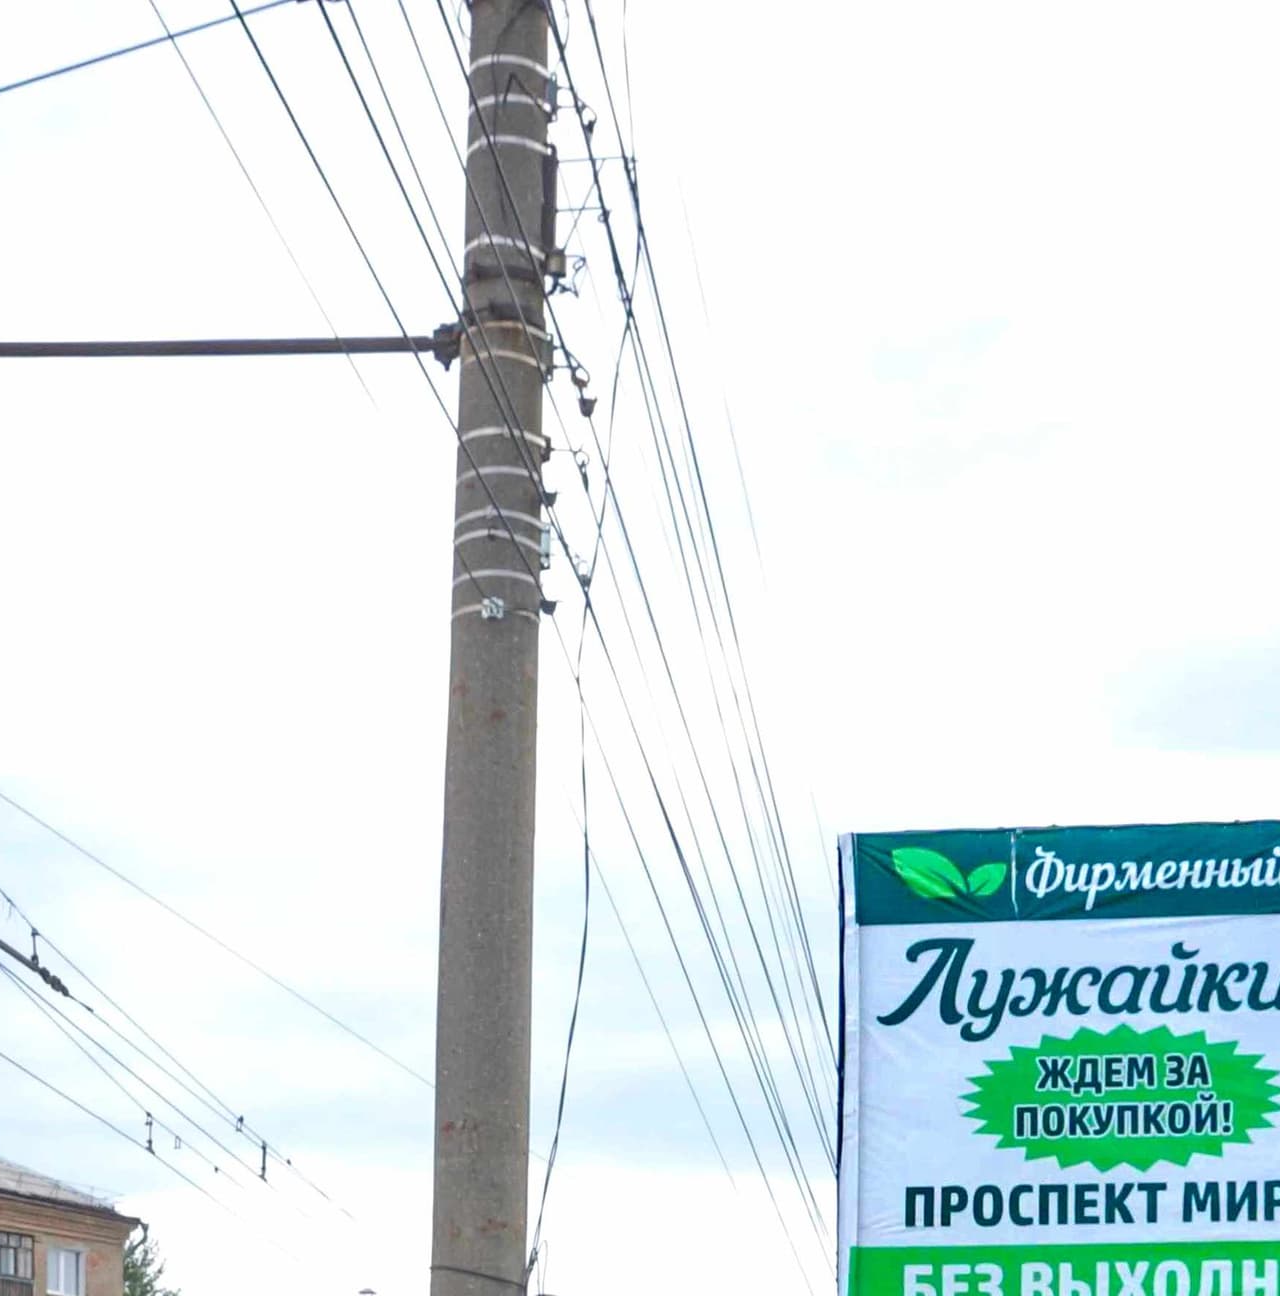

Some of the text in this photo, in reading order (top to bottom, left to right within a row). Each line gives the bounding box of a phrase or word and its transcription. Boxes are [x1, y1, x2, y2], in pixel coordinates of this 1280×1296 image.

[1036, 1054, 1210, 1094] ЖДЕМ ЗА
[1015, 1094, 1234, 1138] ПОКУПКОЙ!
[904, 1182, 1168, 1229] ПРОСПЕКТ
